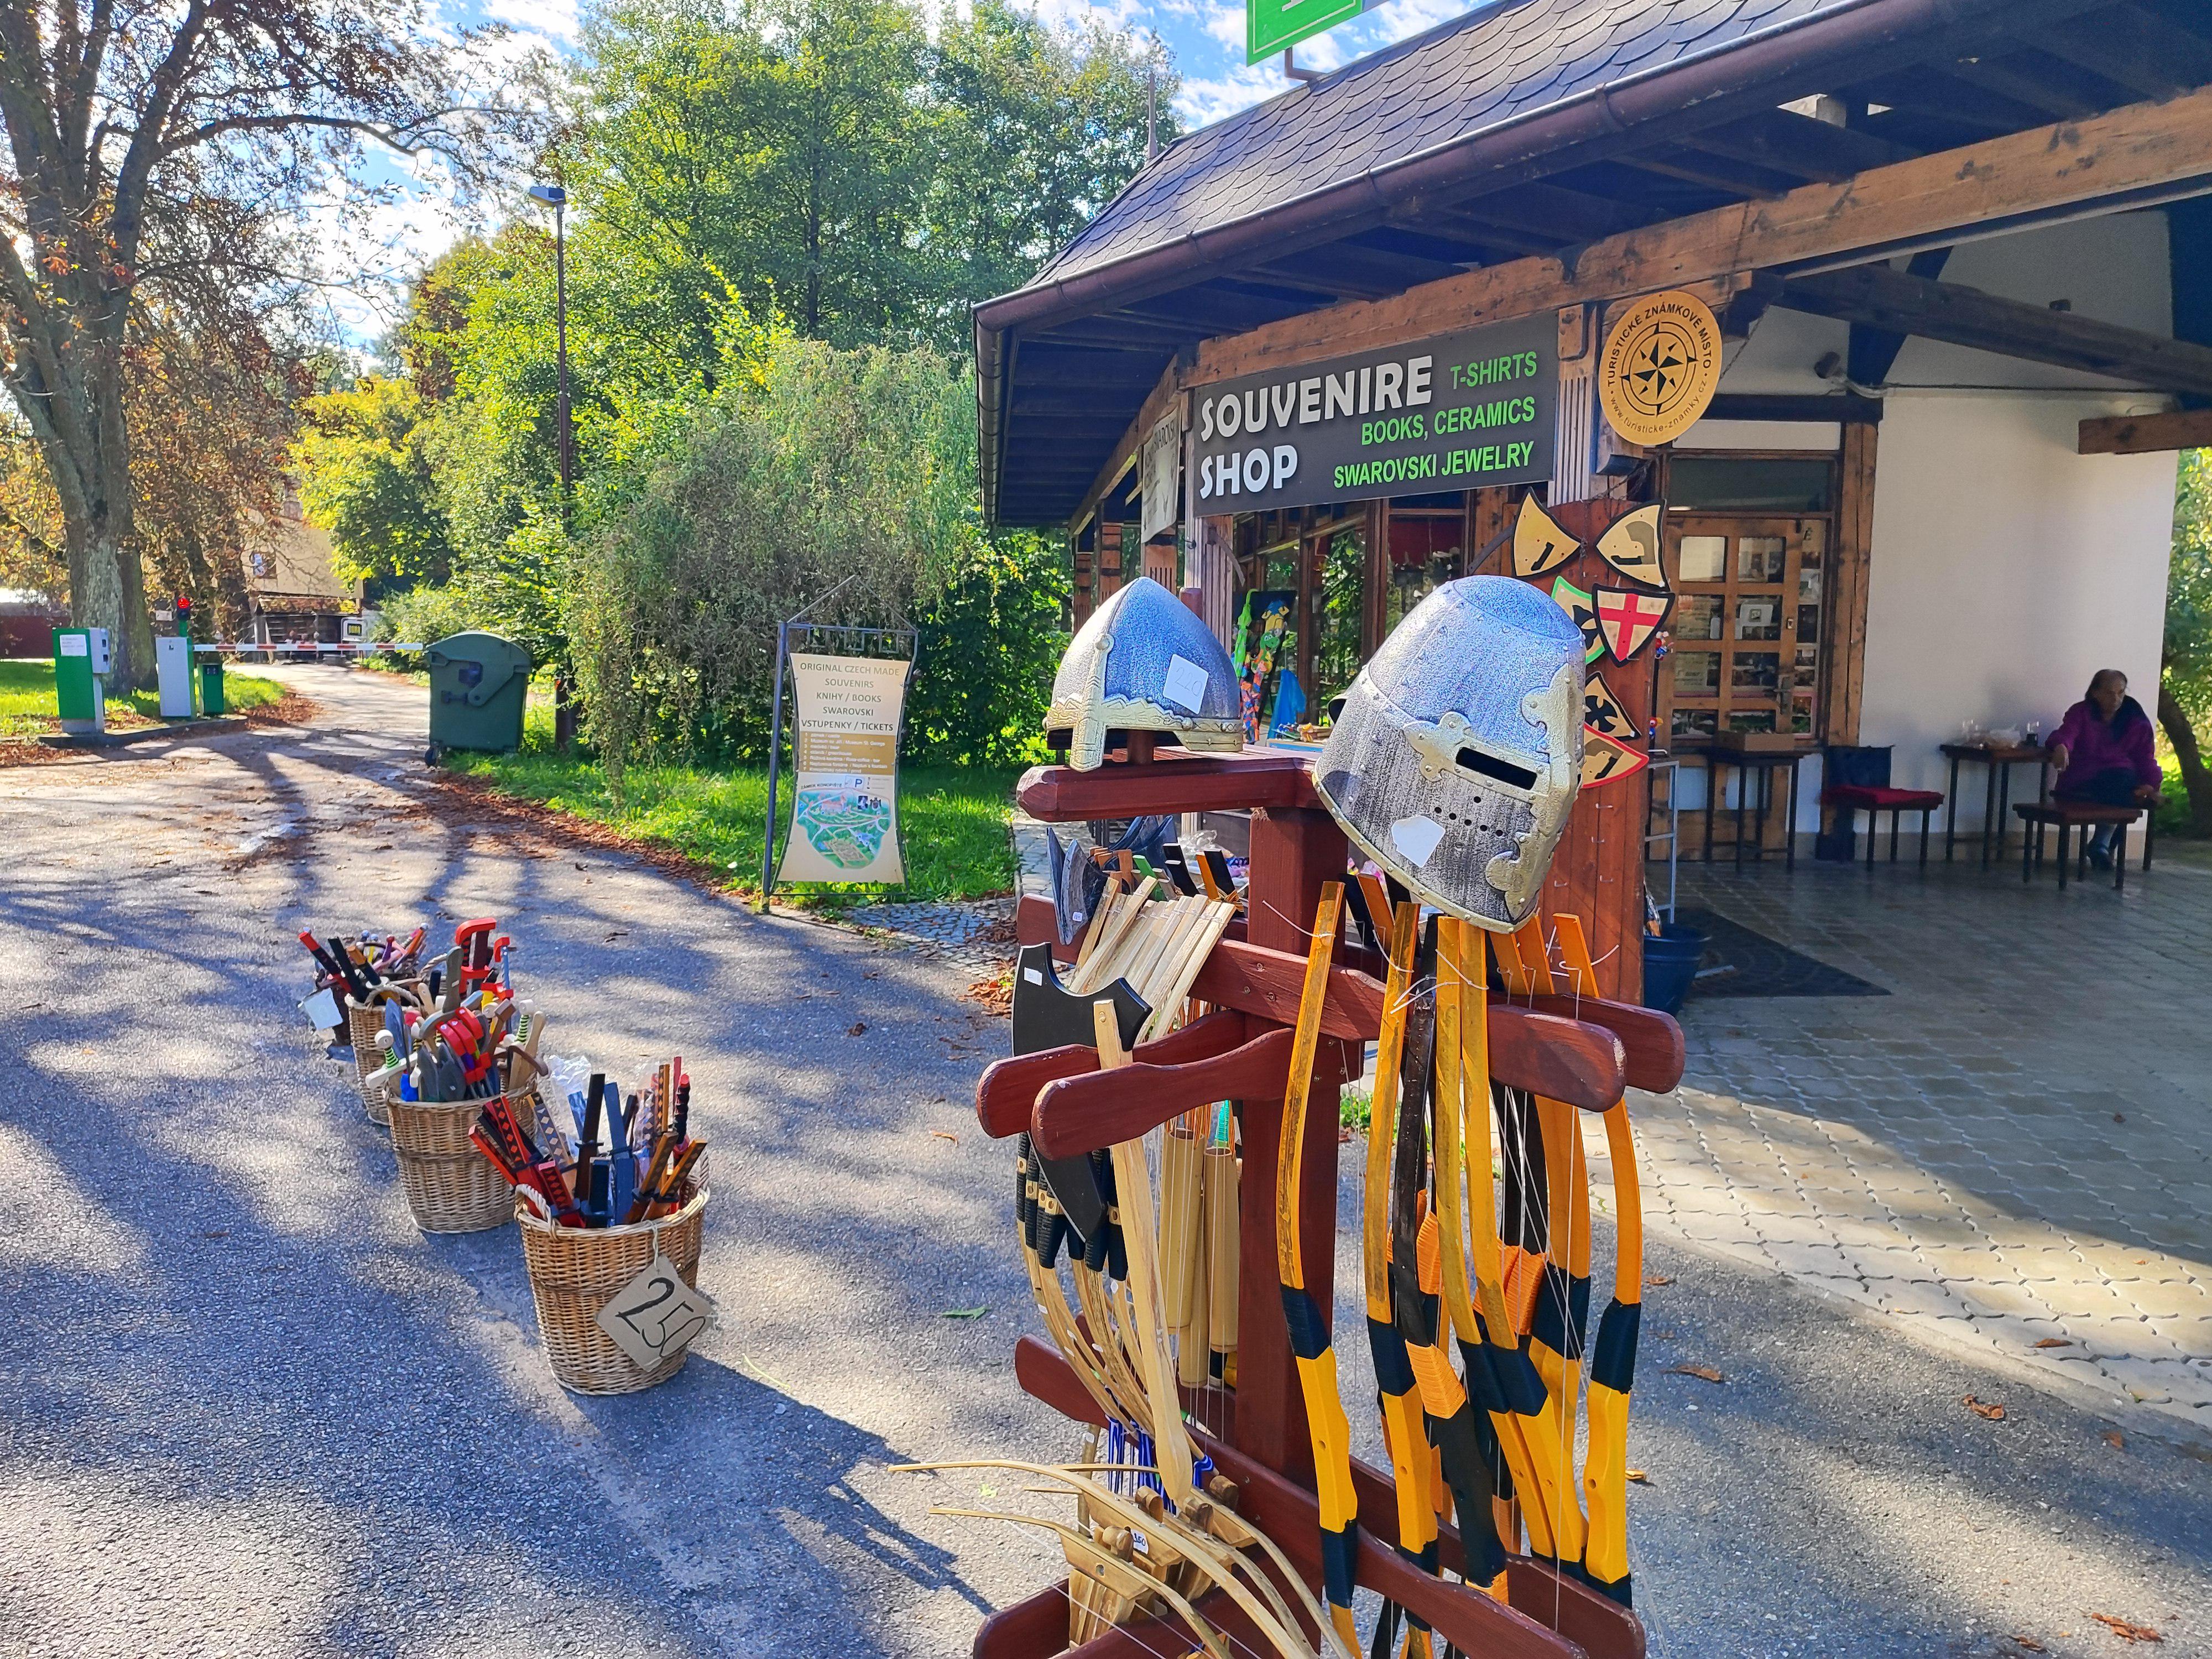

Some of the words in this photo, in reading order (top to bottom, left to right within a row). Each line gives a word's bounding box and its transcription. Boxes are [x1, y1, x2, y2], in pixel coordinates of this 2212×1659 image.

[1607, 314, 1642, 387] TURISTICKÉ
[1644, 301, 1703, 330] ZNÁMKOVÉ
[1698, 327, 1712, 369] MÍSTO
[1450, 351, 1537, 389] T-SHIRTS
[1201, 355, 1433, 442] SOUVENIRE
[1610, 379, 1707, 434] www.turisticke-znamky.cz
[1361, 414, 1428, 446] BOOKS,
[1434, 396, 1535, 435] CERAMICS
[1199, 445, 1298, 499] SHOP
[1333, 453, 1437, 489] SWAROVSKI
[1441, 440, 1535, 476] JEWELRY
[800, 662, 842, 673] ORIGINAL
[844, 665, 872, 674] CZECH
[874, 667, 900, 676] MADE
[825, 678, 874, 688] SOUVENIRS
[1174, 666, 1203, 697] 220
[816, 692, 843, 701] KNIHY
[852, 694, 881, 702] BOOKS
[822, 706, 874, 716] SWAROVSKI
[801, 719, 852, 729] VSTUPENKY
[860, 722, 894, 731] TICKETS
[854, 778, 863, 787] P
[615, 1276, 706, 1358] 250
